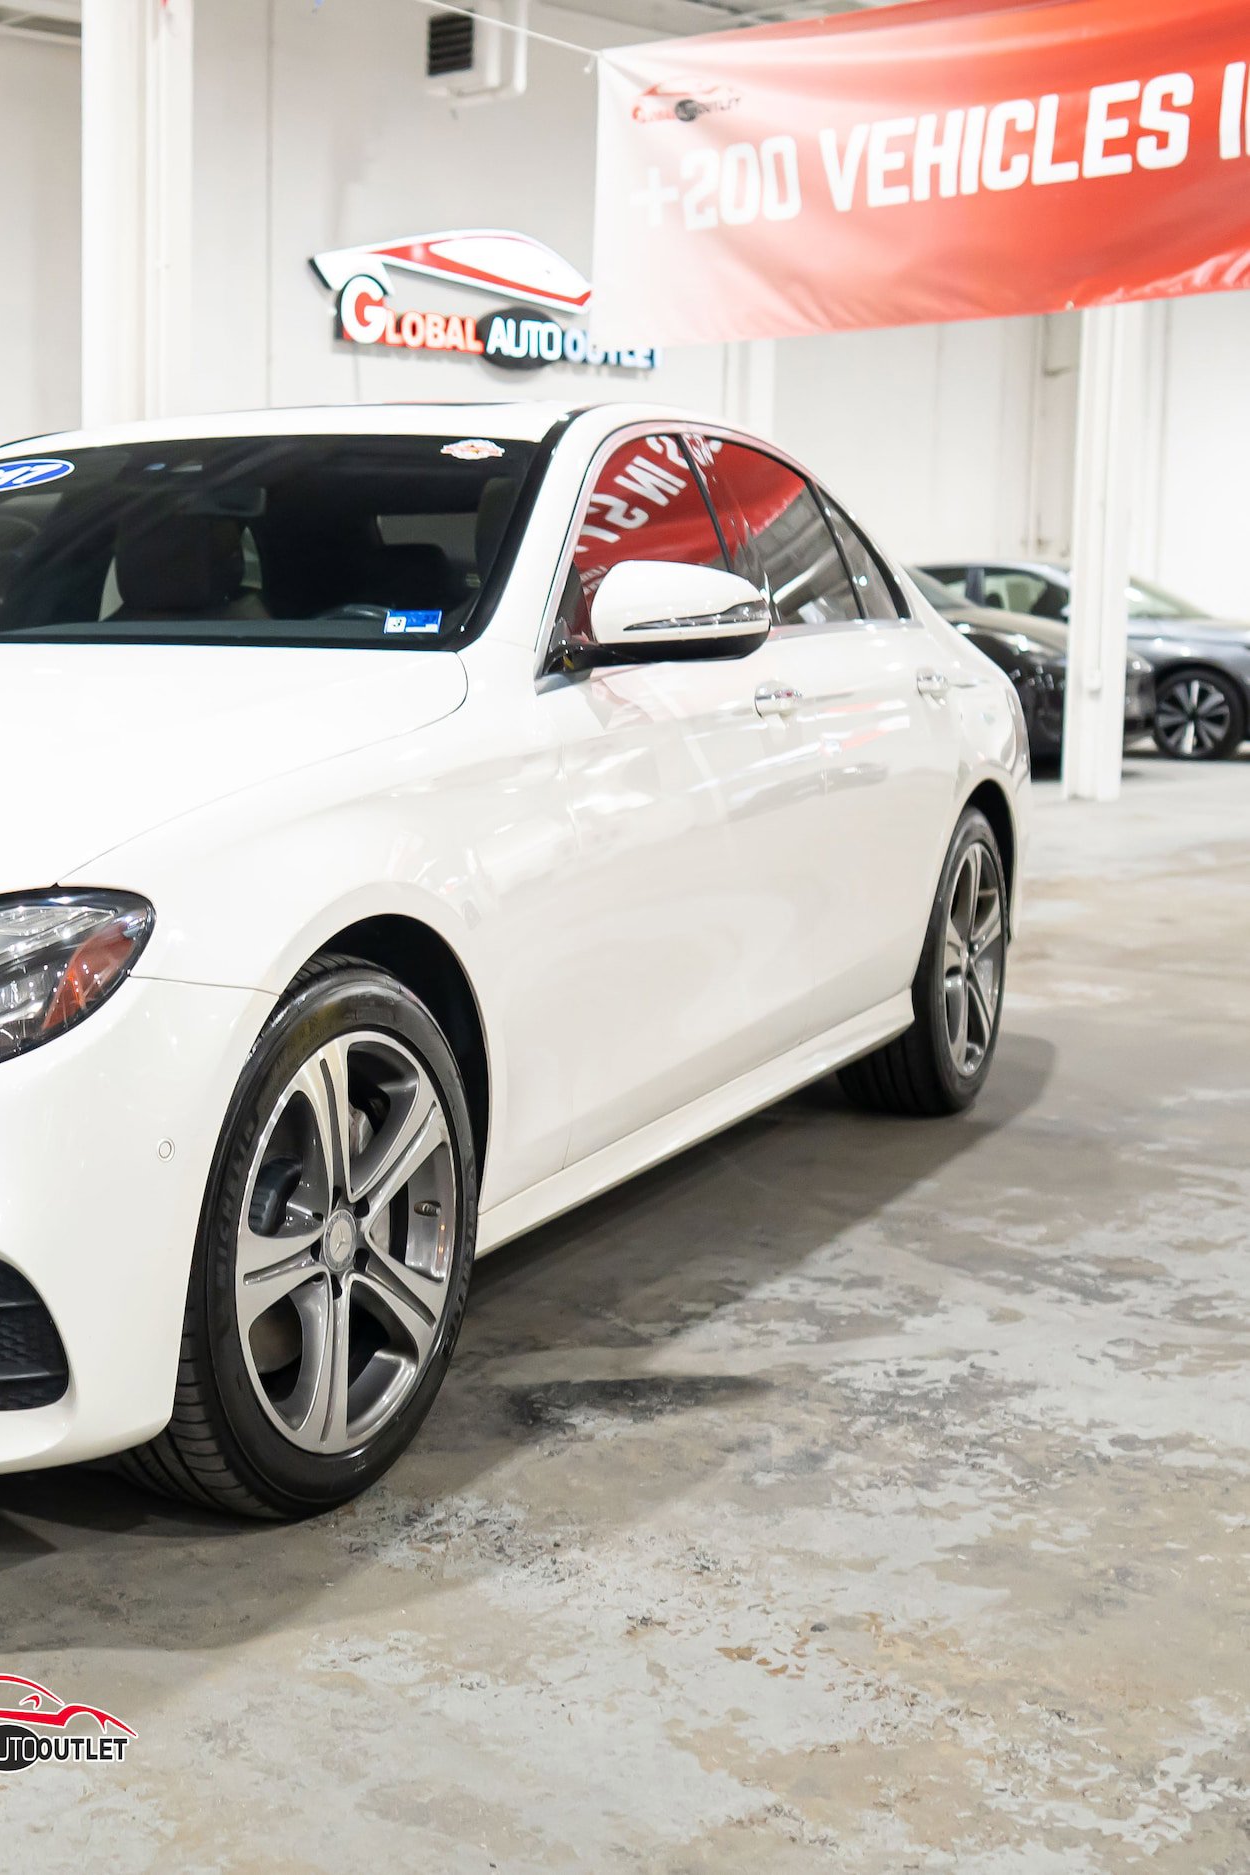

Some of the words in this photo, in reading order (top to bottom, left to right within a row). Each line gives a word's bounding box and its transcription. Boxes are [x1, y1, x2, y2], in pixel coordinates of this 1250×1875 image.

[629, 135, 802, 230] +200
[820, 72, 1194, 211] VEHICLES
[1219, 61, 1250, 160] I
[341, 274, 483, 353] GLOBAL
[486, 317, 561, 360] AUTO
